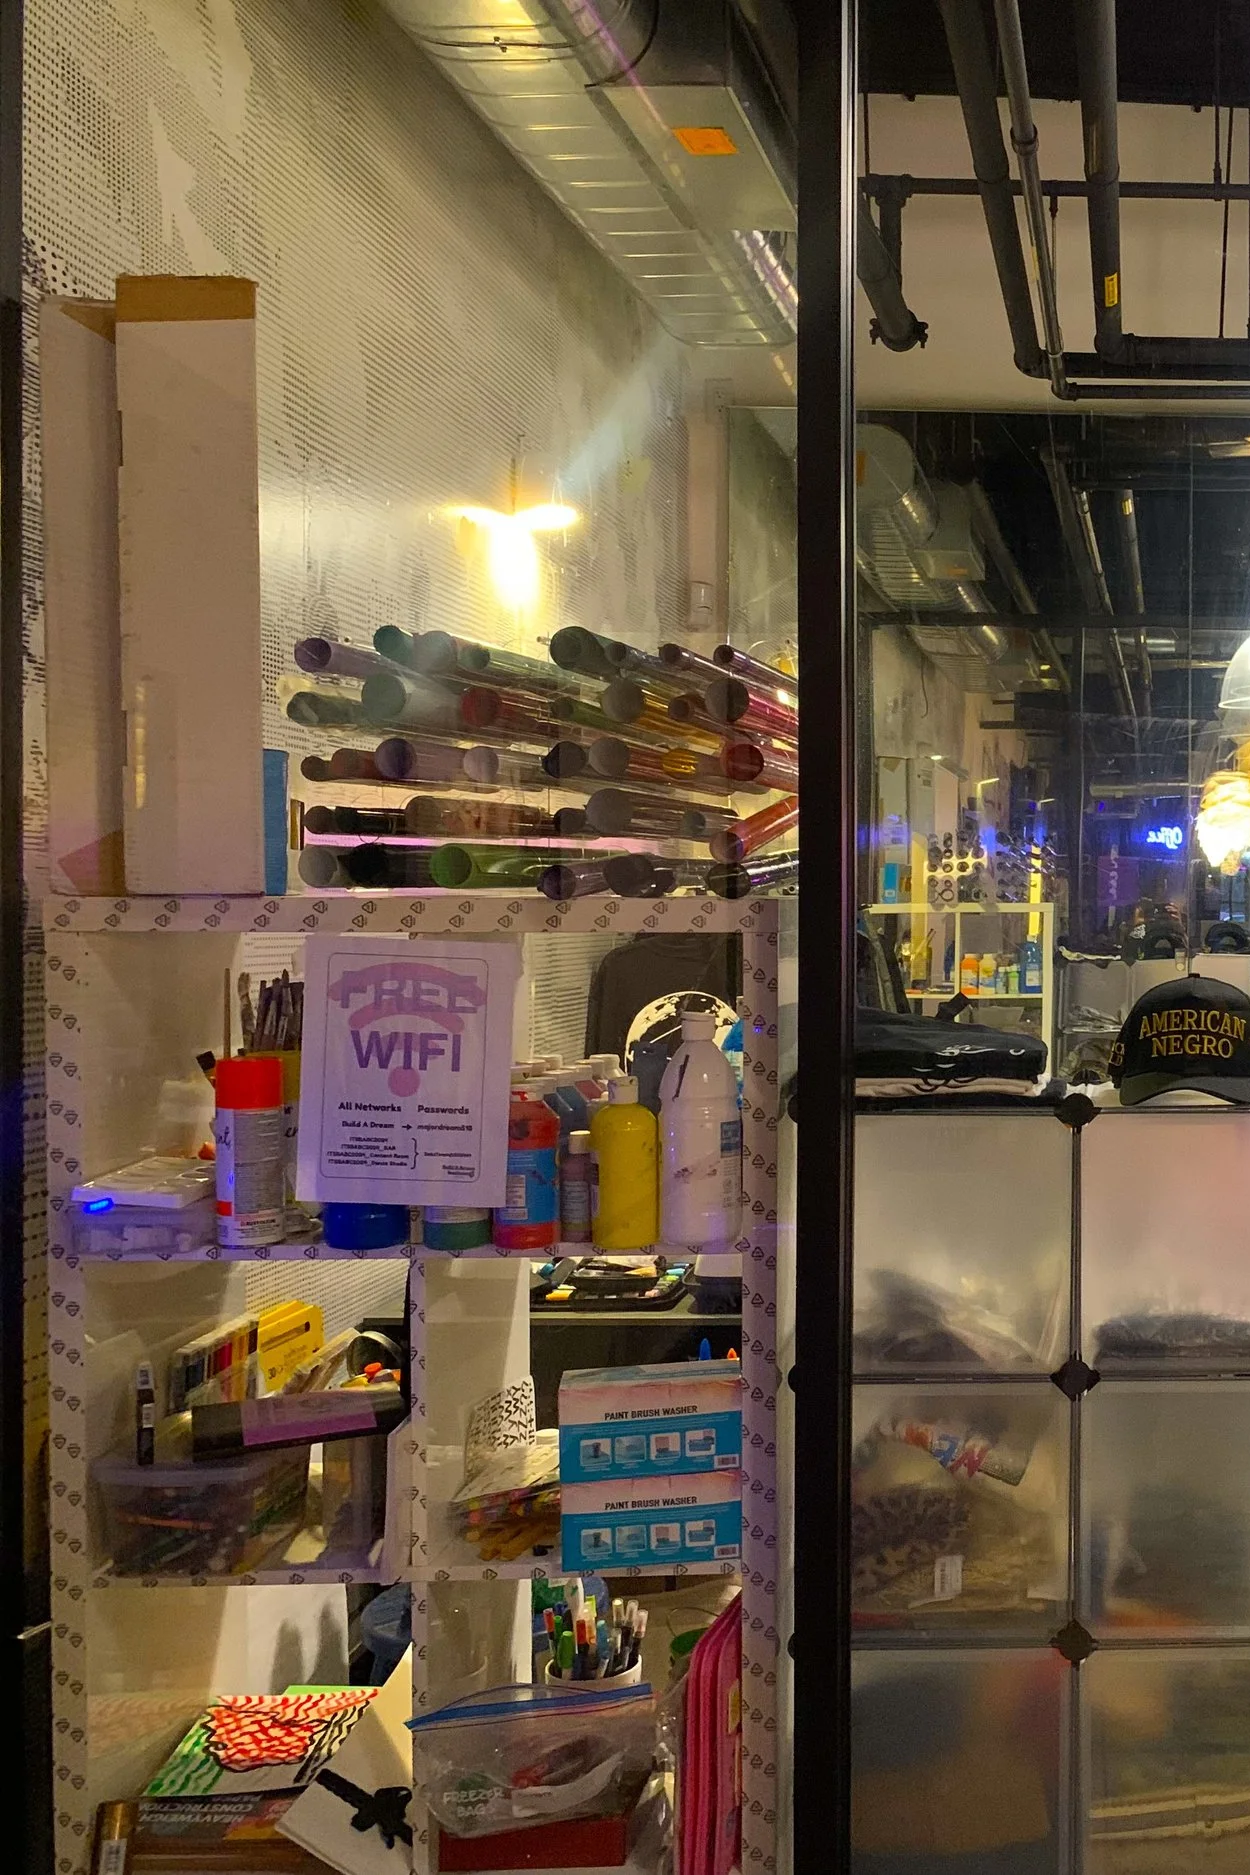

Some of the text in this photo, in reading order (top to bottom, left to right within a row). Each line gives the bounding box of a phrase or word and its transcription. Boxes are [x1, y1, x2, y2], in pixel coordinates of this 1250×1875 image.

[339, 968, 478, 1014] FREE
[1138, 1009, 1247, 1041] AMERICAN
[351, 1030, 462, 1073] WIFI
[1151, 1034, 1234, 1059] NEGRO
[338, 1101, 402, 1112] All Networks
[417, 1105, 469, 1114] Passwords
[604, 1405, 698, 1420] PAINT BRUSH WASHER
[604, 1496, 698, 1511] PAINT BRUSH WASHER
[443, 1787, 505, 1804] FREEZER
